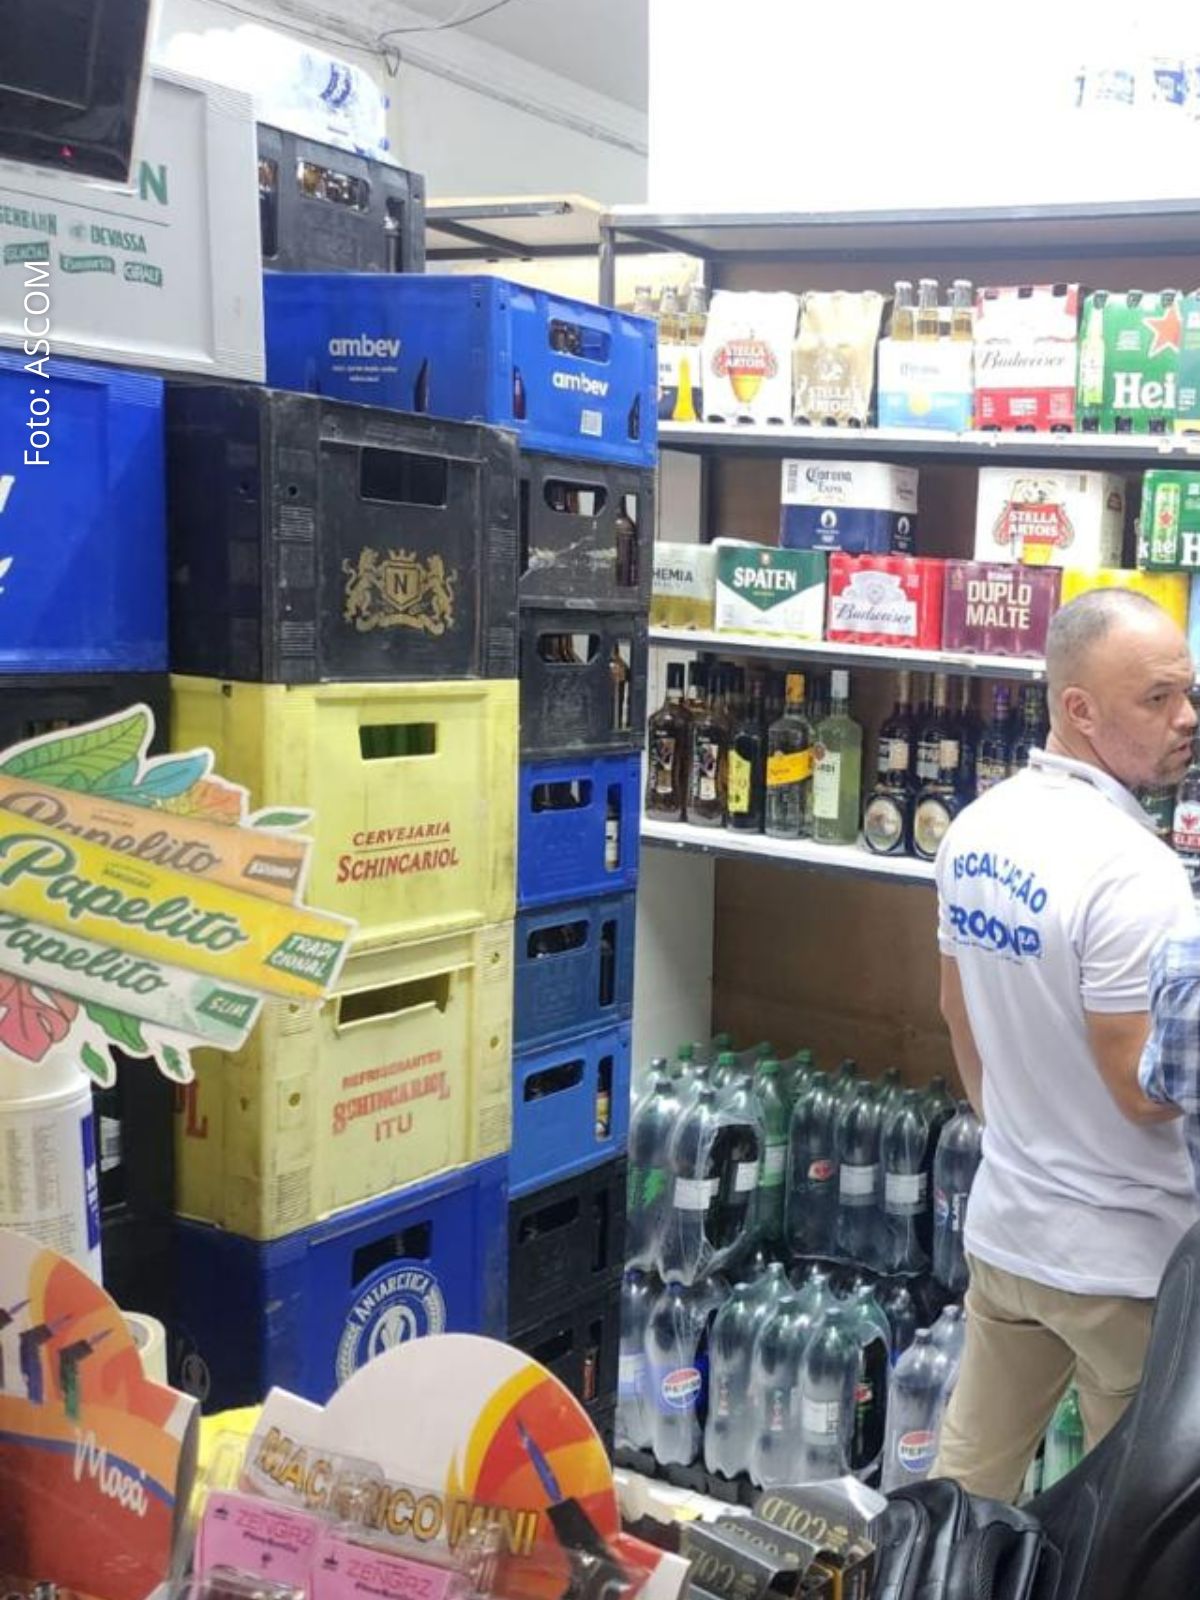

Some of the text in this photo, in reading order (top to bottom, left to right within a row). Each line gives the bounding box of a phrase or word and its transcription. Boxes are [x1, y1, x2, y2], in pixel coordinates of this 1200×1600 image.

[90, 225, 147, 253] DEVASSA
[328, 334, 401, 358] ambev
[980, 350, 1065, 370] Budweiser
[552, 371, 609, 397] ambev
[1008, 510, 1057, 523] STELLA
[1008, 523, 1059, 536] ARTOIS
[652, 567, 693, 583] HEMIA
[732, 566, 797, 591] SPATEN
[967, 580, 1032, 607] DUPLO
[836, 602, 912, 625] Budweiser
[965, 605, 1031, 630] MALTE
[352, 821, 452, 847] CERVEJARIA
[336, 847, 461, 883] SCHINCARIOL
[0, 833, 248, 953] Papelito
[207, 996, 250, 1020] SLIM
[374, 1112, 414, 1142] ITU
[760, 1494, 829, 1541] GOLD
